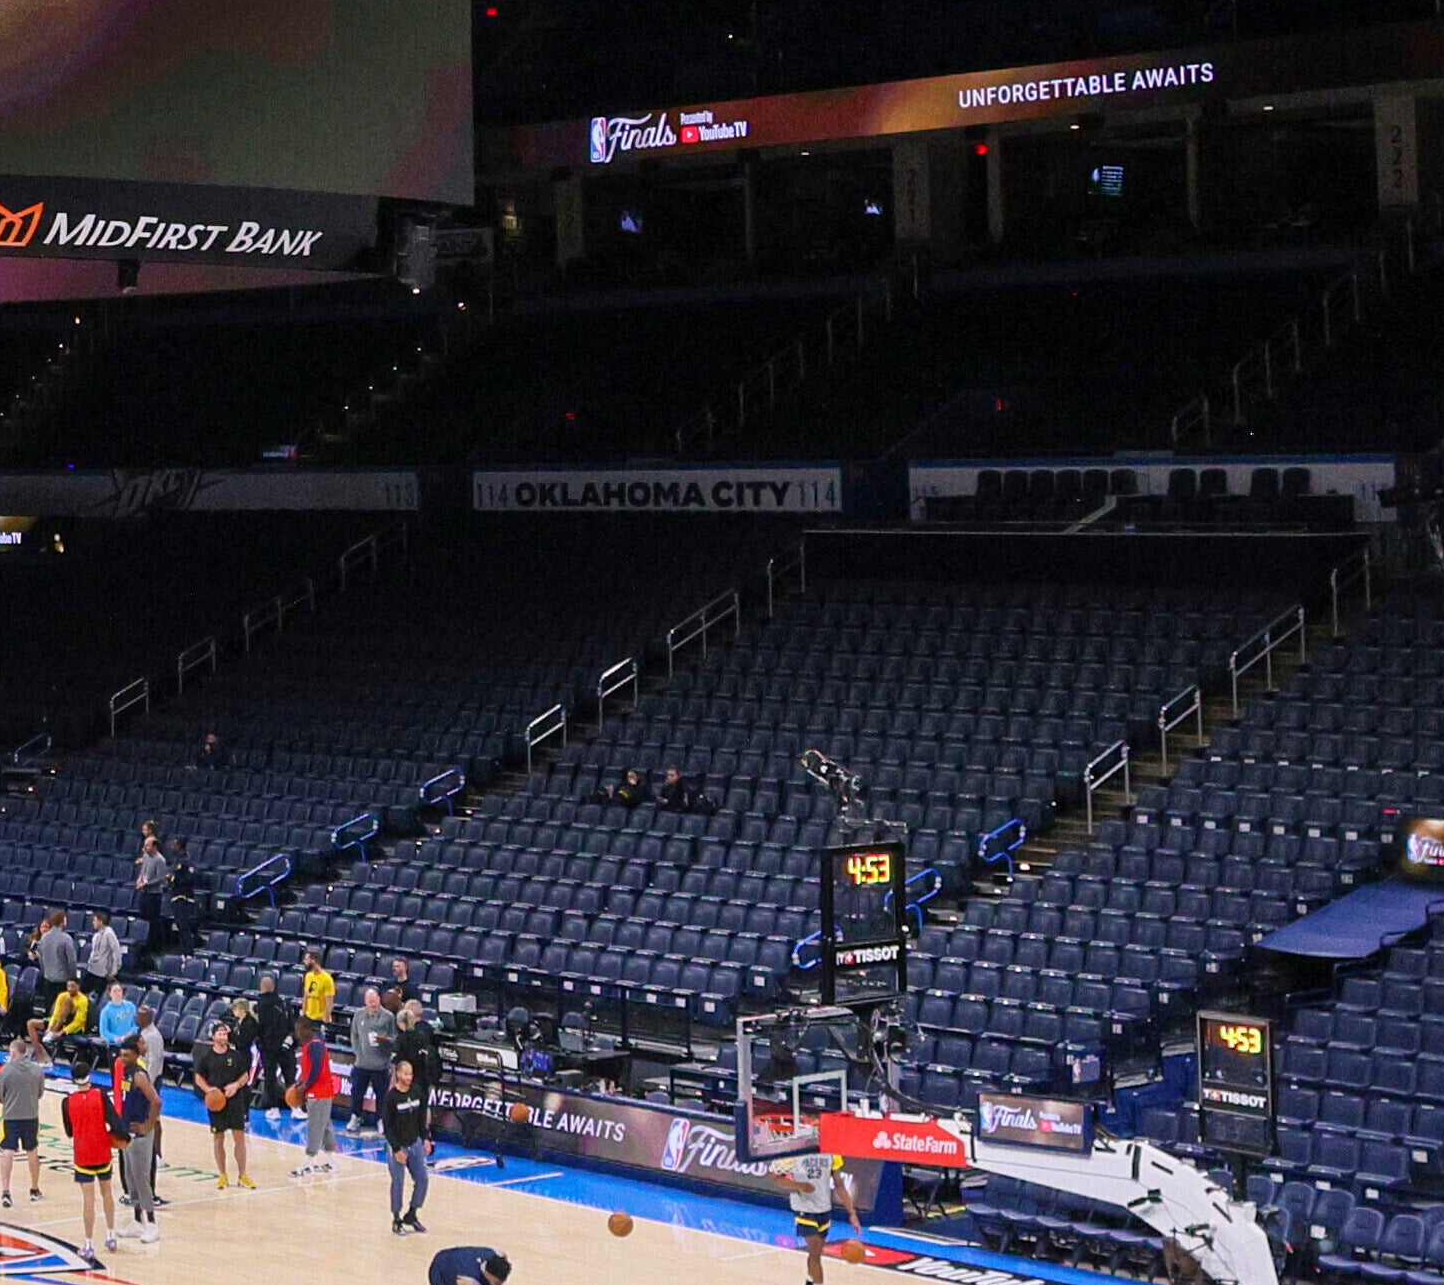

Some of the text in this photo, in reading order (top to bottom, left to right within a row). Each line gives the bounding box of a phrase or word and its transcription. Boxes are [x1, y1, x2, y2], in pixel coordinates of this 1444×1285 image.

[959, 62, 1214, 108] UNFORGETTABLE AWAITS
[604, 112, 677, 163] Finals
[477, 481, 509, 512] 114
[514, 479, 792, 509] OKLAHOMA CITY
[797, 479, 837, 509] 114
[847, 853, 890, 885] 4:53
[855, 945, 900, 964] TISSOT
[1221, 1090, 1267, 1108] TISSOT
[555, 1112, 627, 1141] AWAITS
[988, 1105, 1038, 1134] Finals
